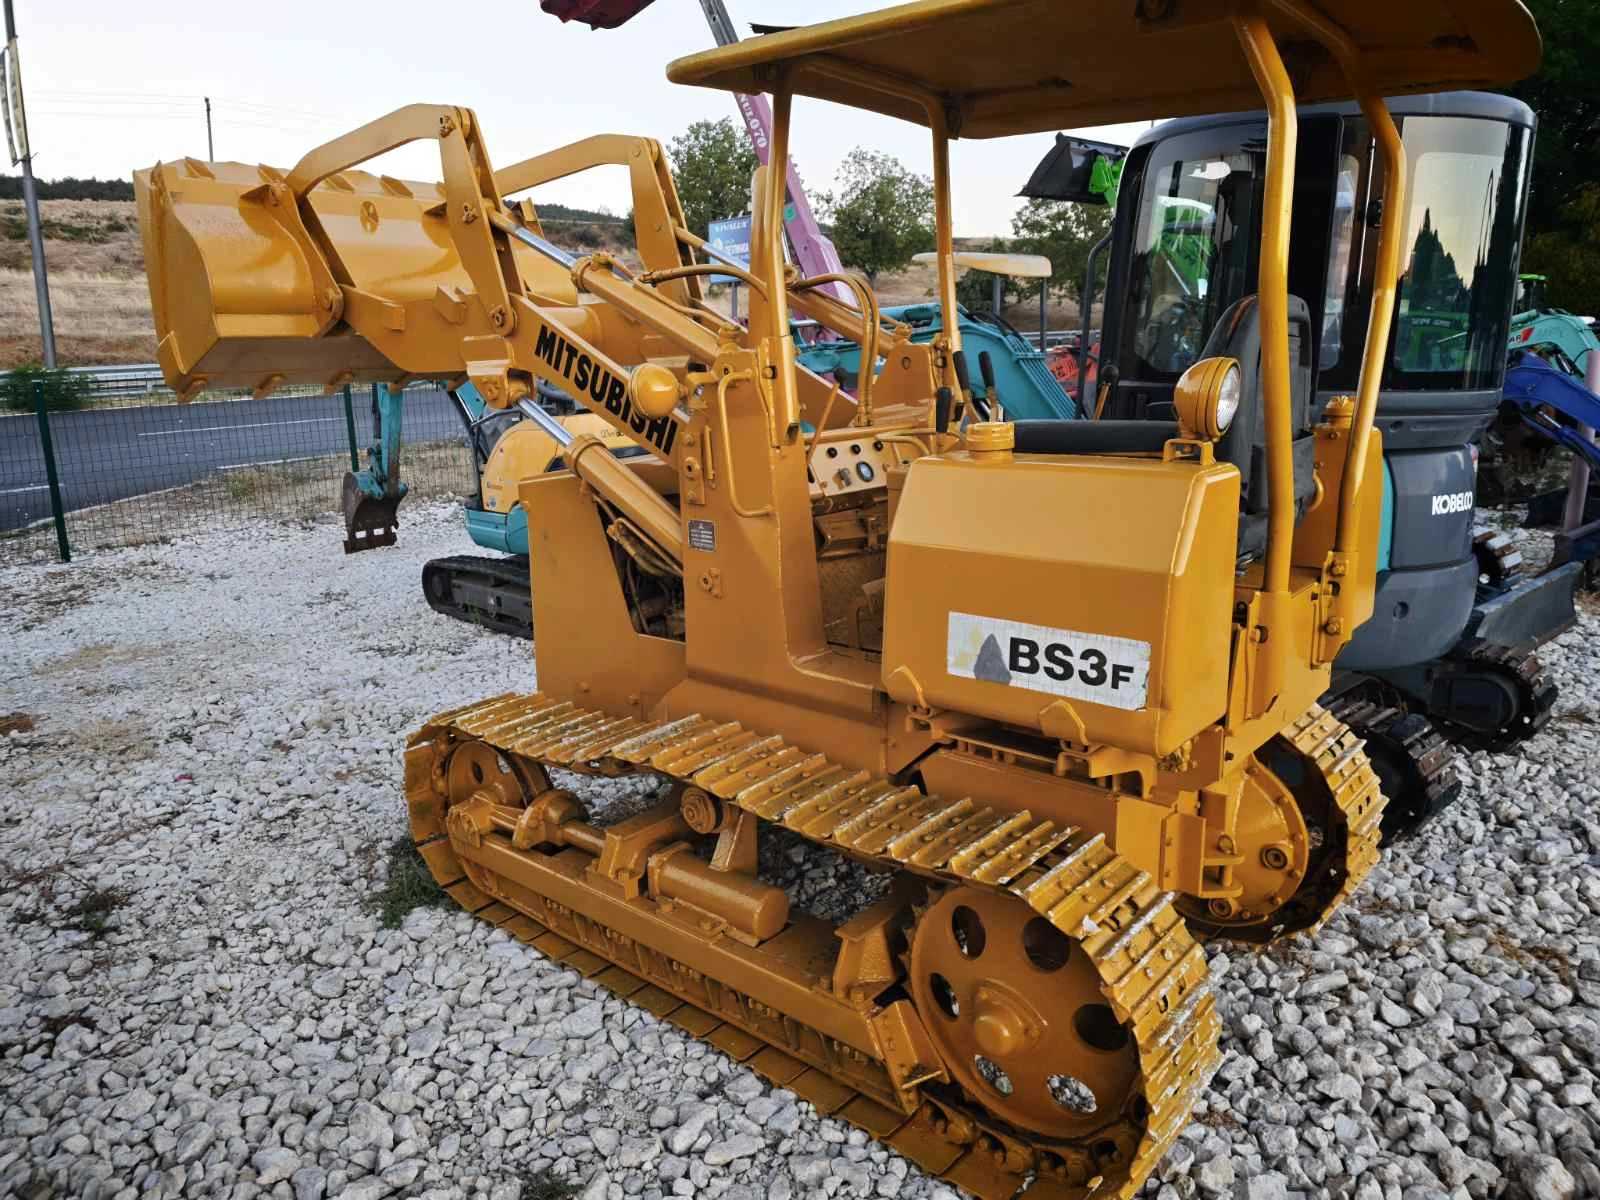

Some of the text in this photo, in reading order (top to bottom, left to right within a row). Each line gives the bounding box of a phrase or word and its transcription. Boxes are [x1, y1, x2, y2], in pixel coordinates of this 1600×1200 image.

[534, 323, 678, 456] MITSUBISHI
[1431, 491, 1473, 515] KOBELCO
[1008, 636, 1134, 690] BS3F
